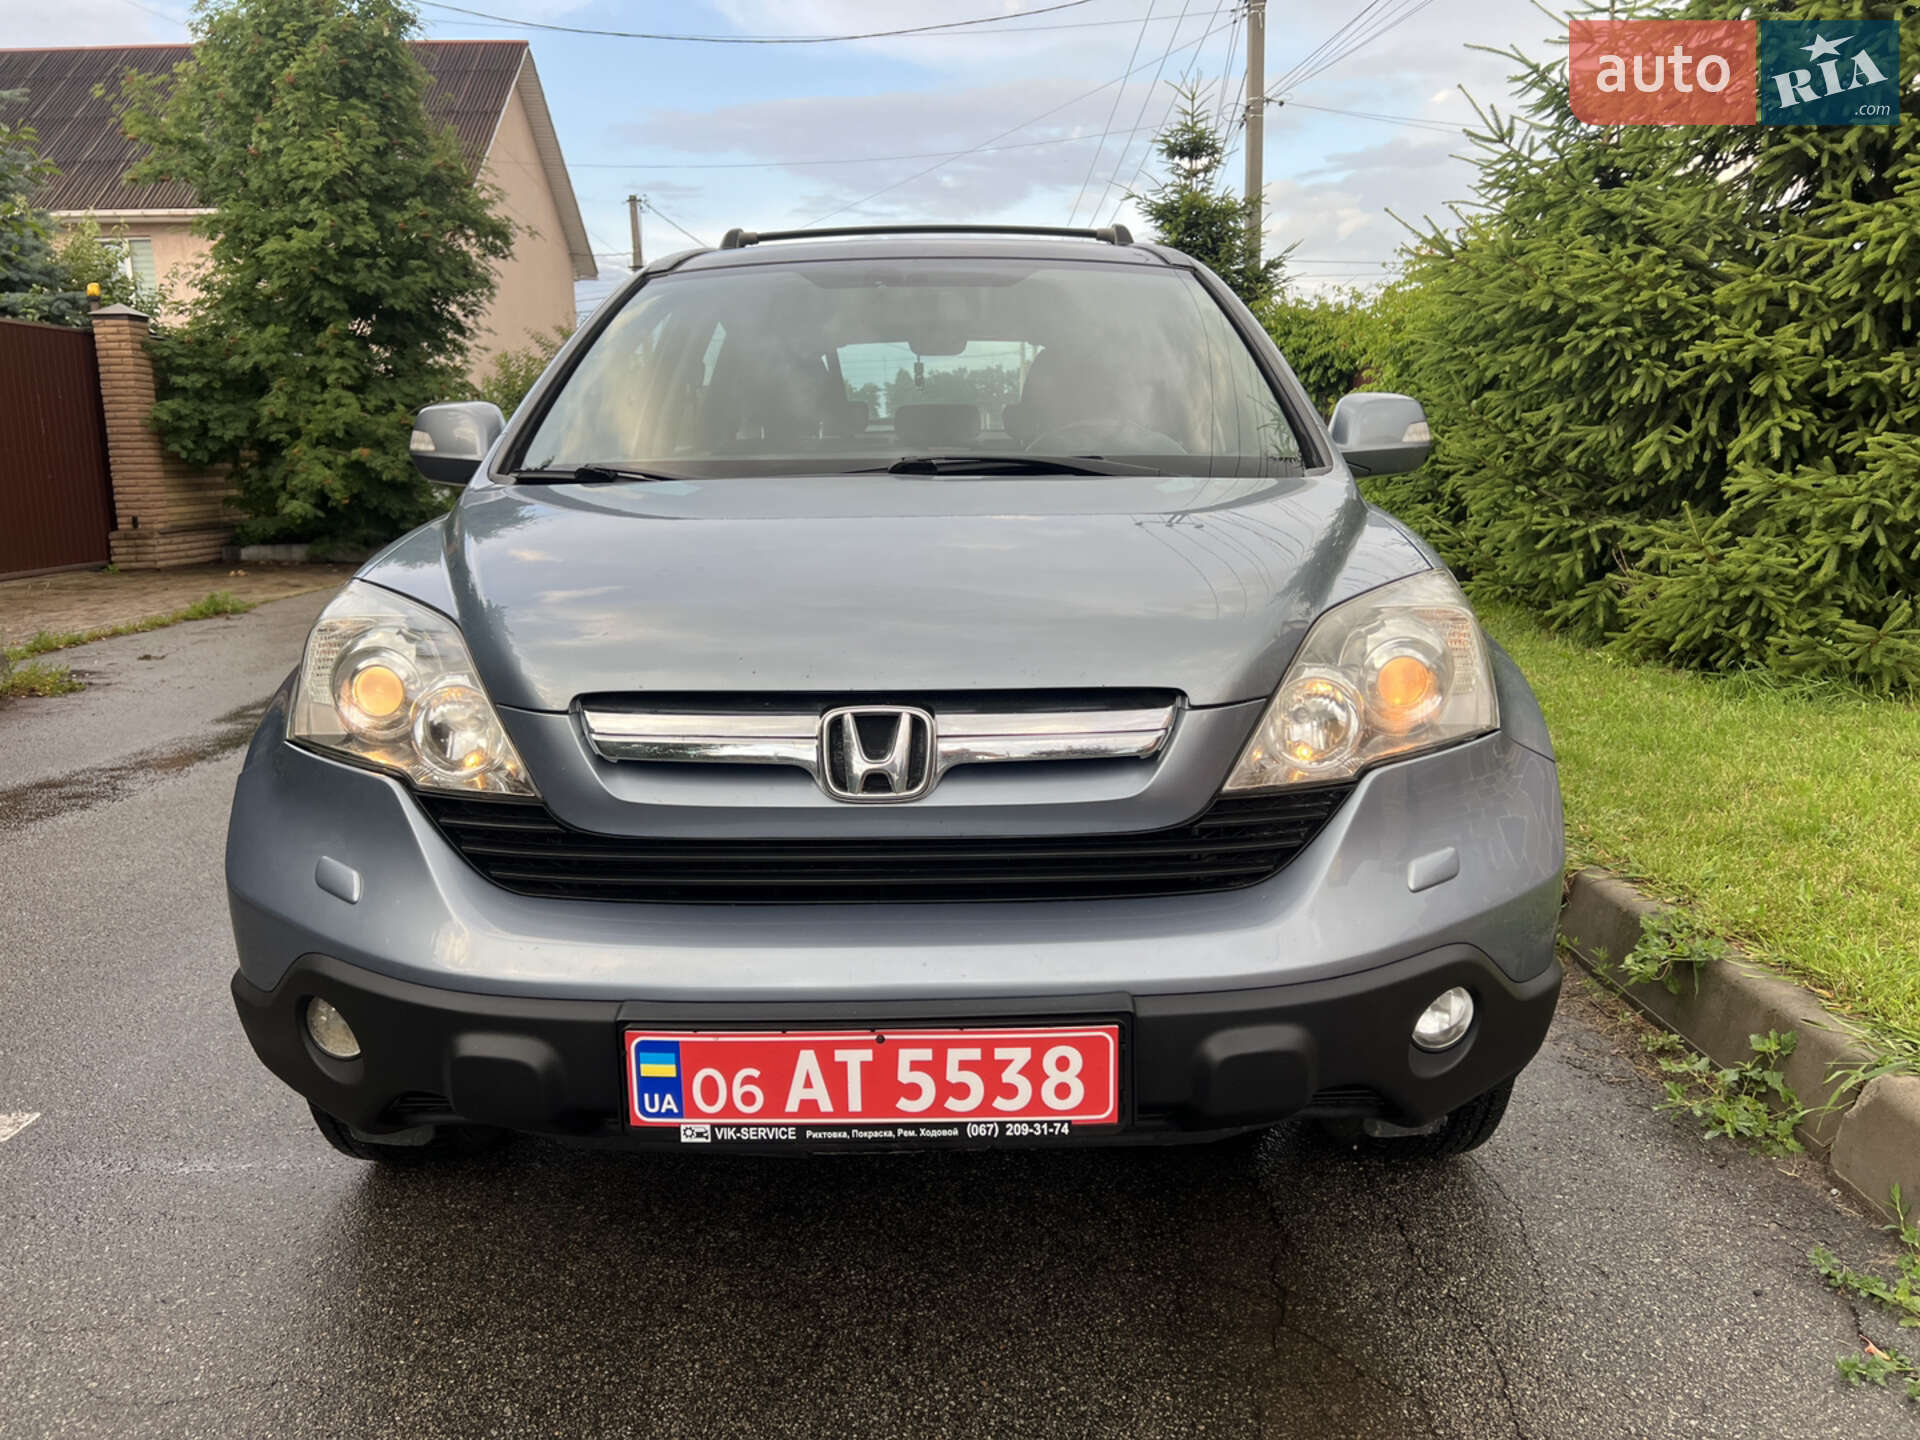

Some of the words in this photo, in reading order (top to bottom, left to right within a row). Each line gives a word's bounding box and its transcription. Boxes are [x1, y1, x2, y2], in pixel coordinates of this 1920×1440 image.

[691, 1067, 765, 1114] 06
[784, 1048, 873, 1113] AT
[894, 1045, 1085, 1113] 5538
[643, 1092, 680, 1114] UA
[714, 1127, 797, 1140] VIK-SERVICE
[805, 1129, 850, 1140] Рихтовка,
[851, 1128, 896, 1139] Покраска,
[897, 1128, 918, 1138] Рем.
[919, 1127, 959, 1138] Ходовой
[966, 1123, 999, 1138] (067)
[1005, 1122, 1070, 1136] 209-31-74
